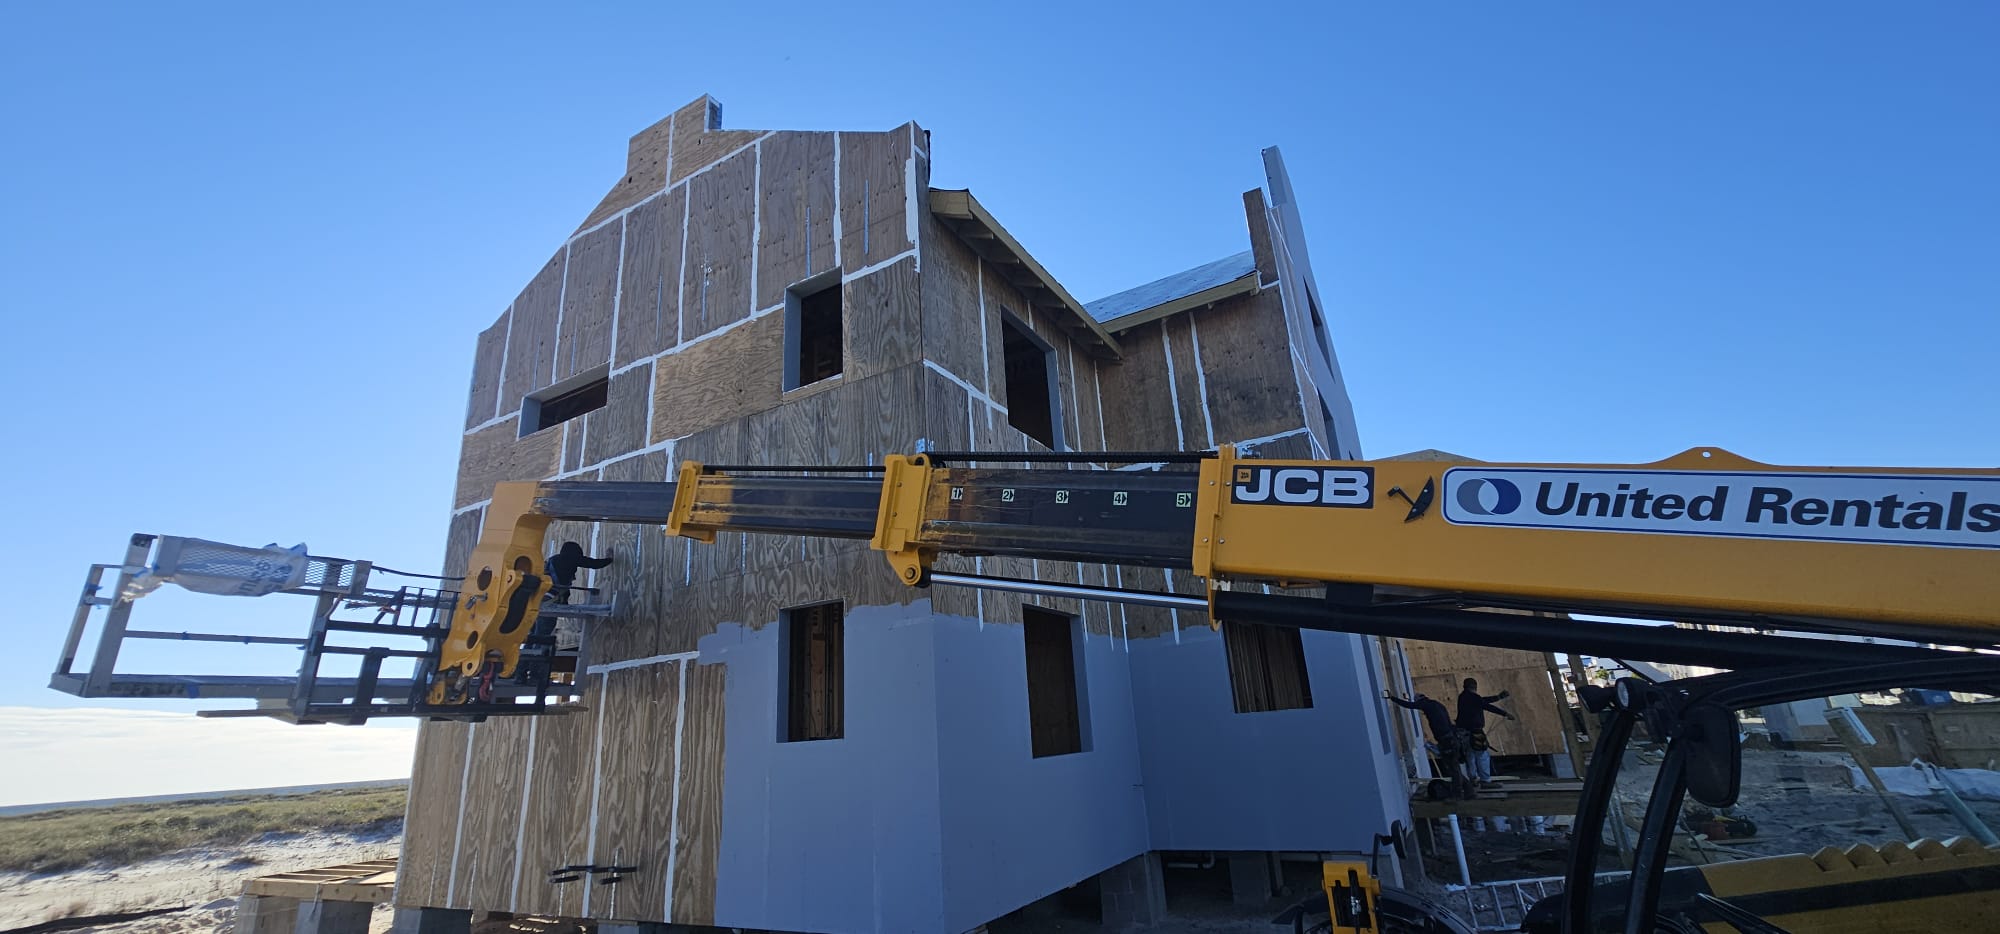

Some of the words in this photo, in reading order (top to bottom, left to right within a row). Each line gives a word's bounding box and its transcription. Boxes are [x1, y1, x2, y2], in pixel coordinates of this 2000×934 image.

[1235, 468, 1370, 505] JCB
[1535, 481, 1730, 522] United
[1745, 486, 2000, 533] Rentals
